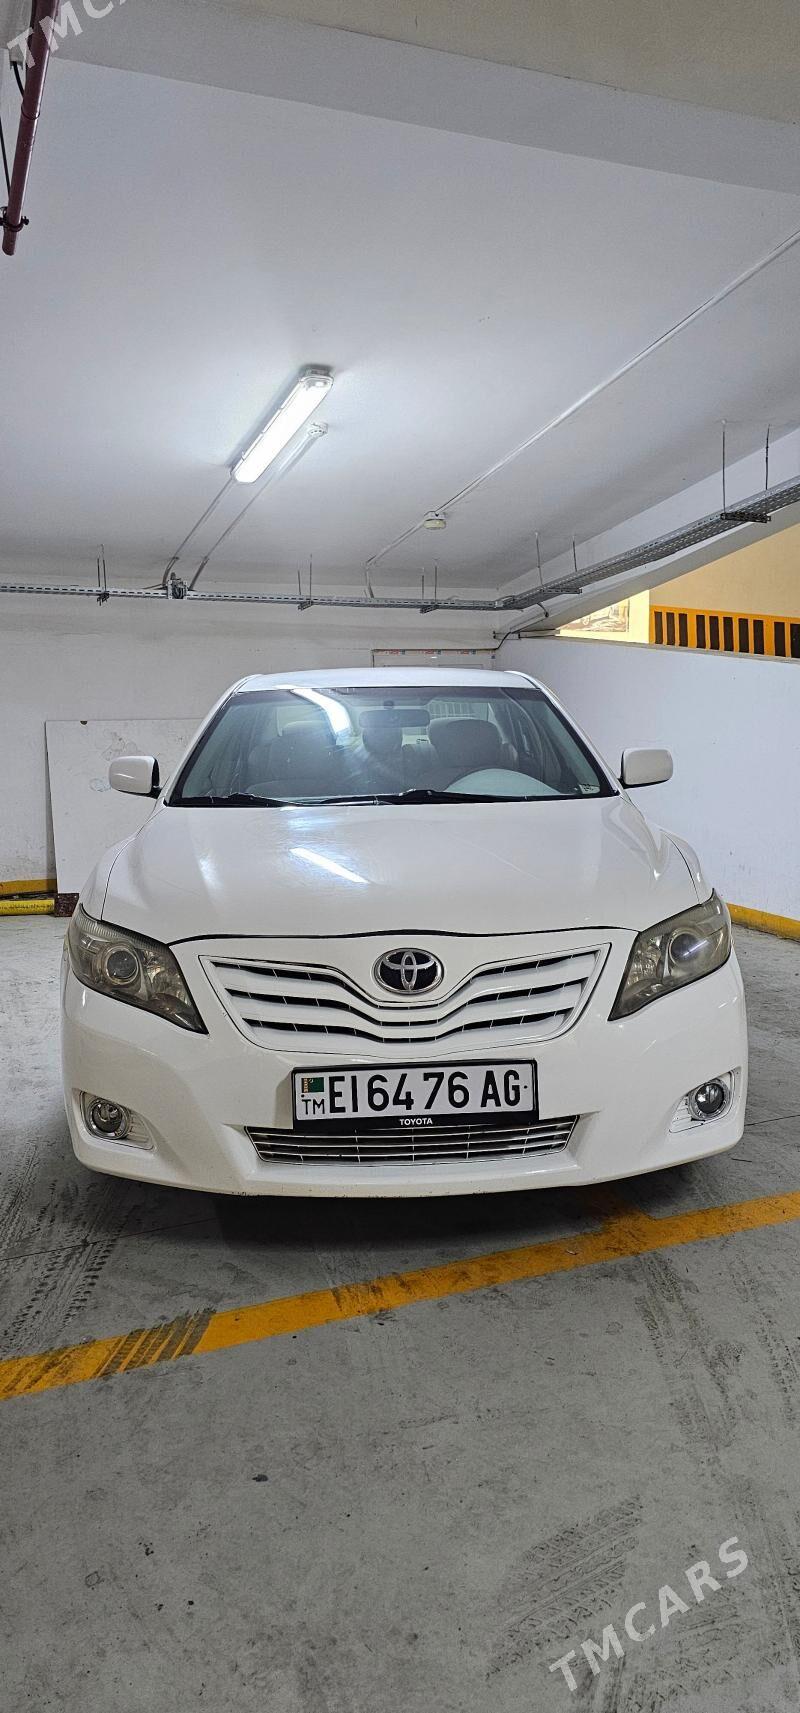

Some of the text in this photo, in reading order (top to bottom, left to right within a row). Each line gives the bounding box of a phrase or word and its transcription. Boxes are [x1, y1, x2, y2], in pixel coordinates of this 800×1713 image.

[480, 1069, 521, 1108] AG
[301, 1098, 325, 1115] TM
[399, 1117, 433, 1126] TOYOTA
